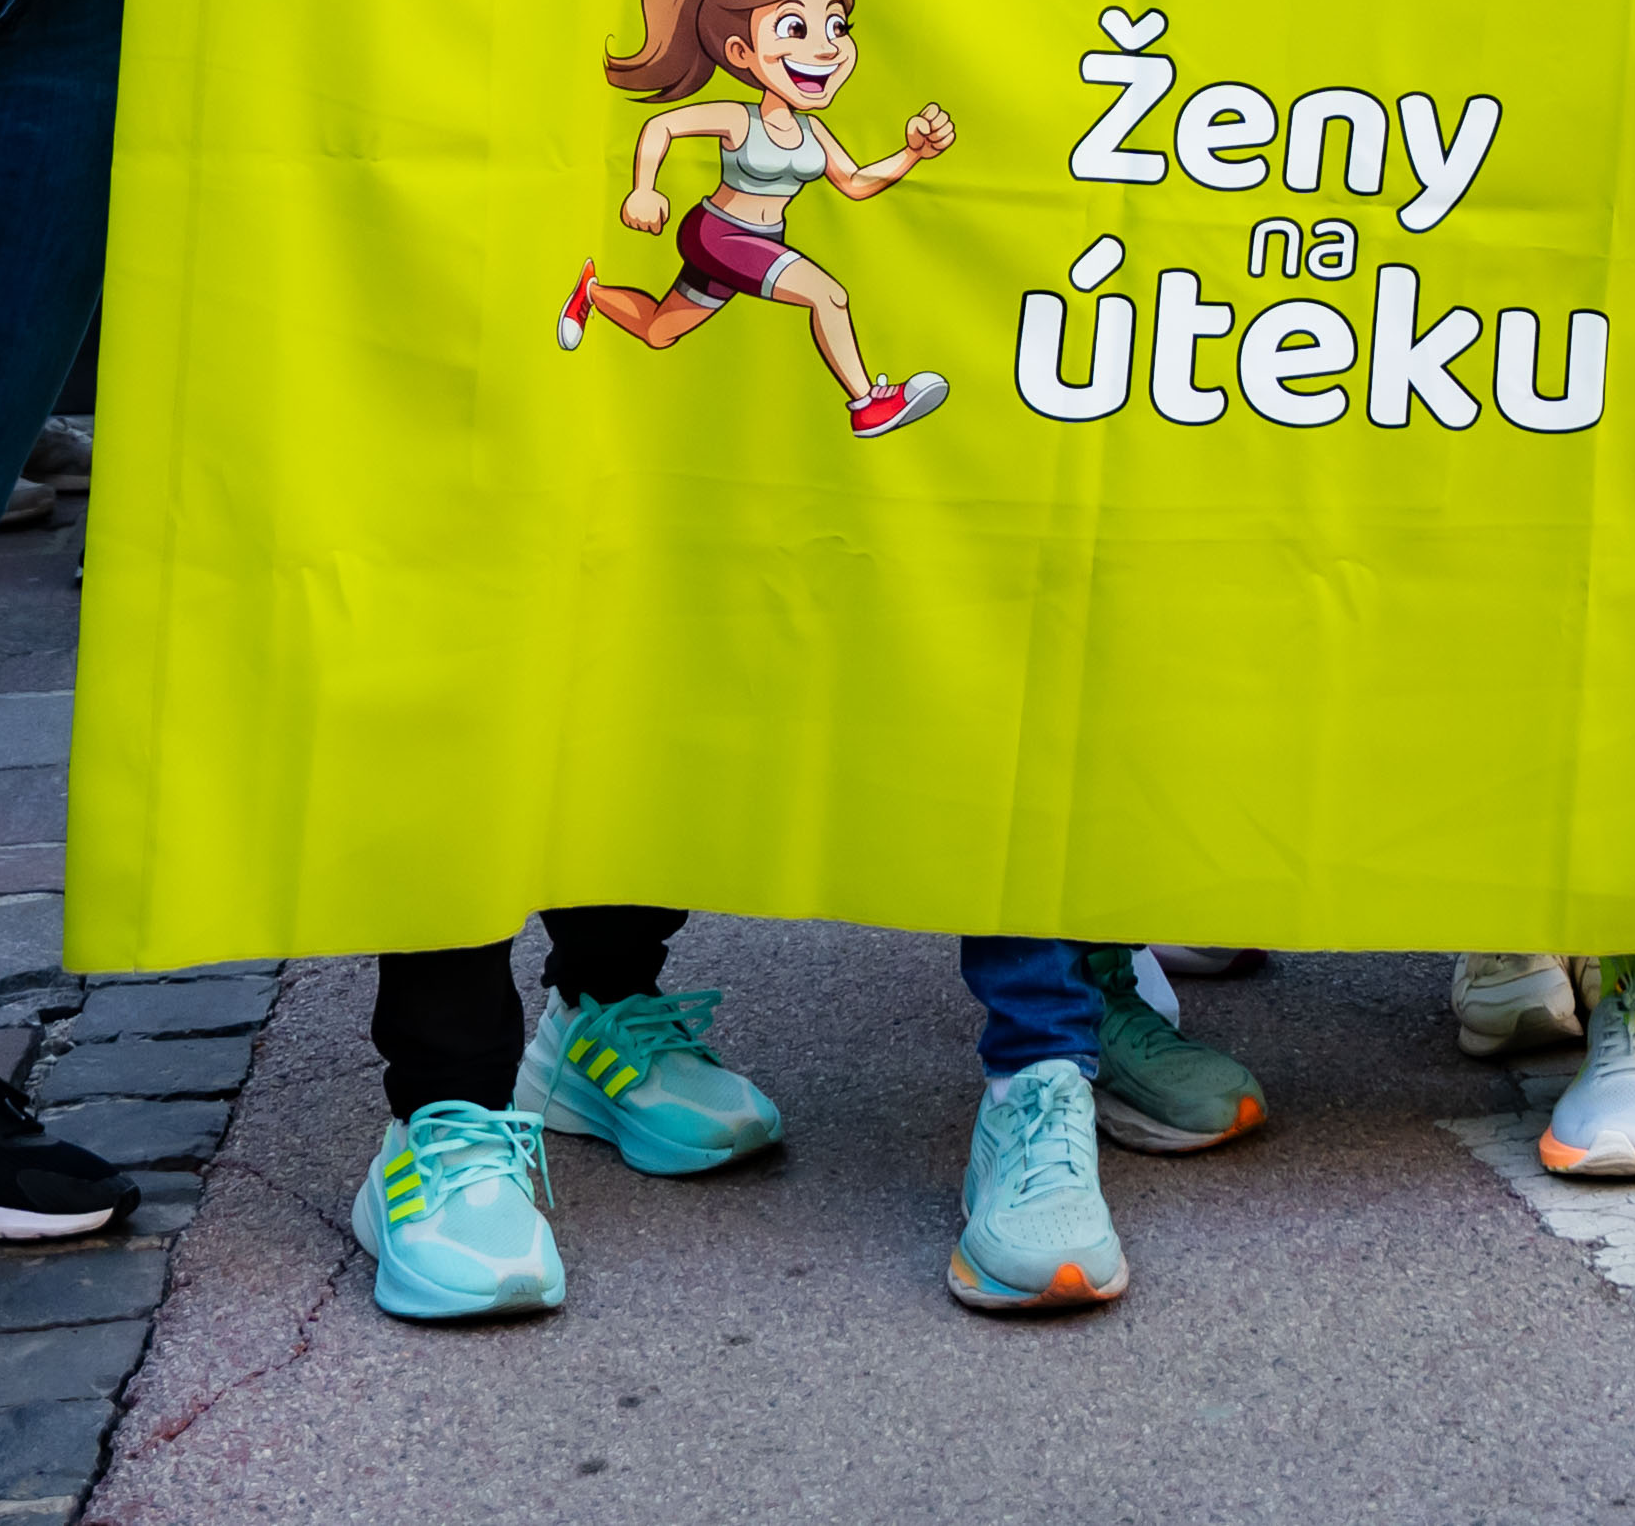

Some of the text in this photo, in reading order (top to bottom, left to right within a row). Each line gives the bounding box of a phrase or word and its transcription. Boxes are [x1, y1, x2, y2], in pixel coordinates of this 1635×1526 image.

[1068, 4, 1502, 233] Ženy
[1013, 233, 1610, 434] úteku
[1247, 215, 1359, 281] na
